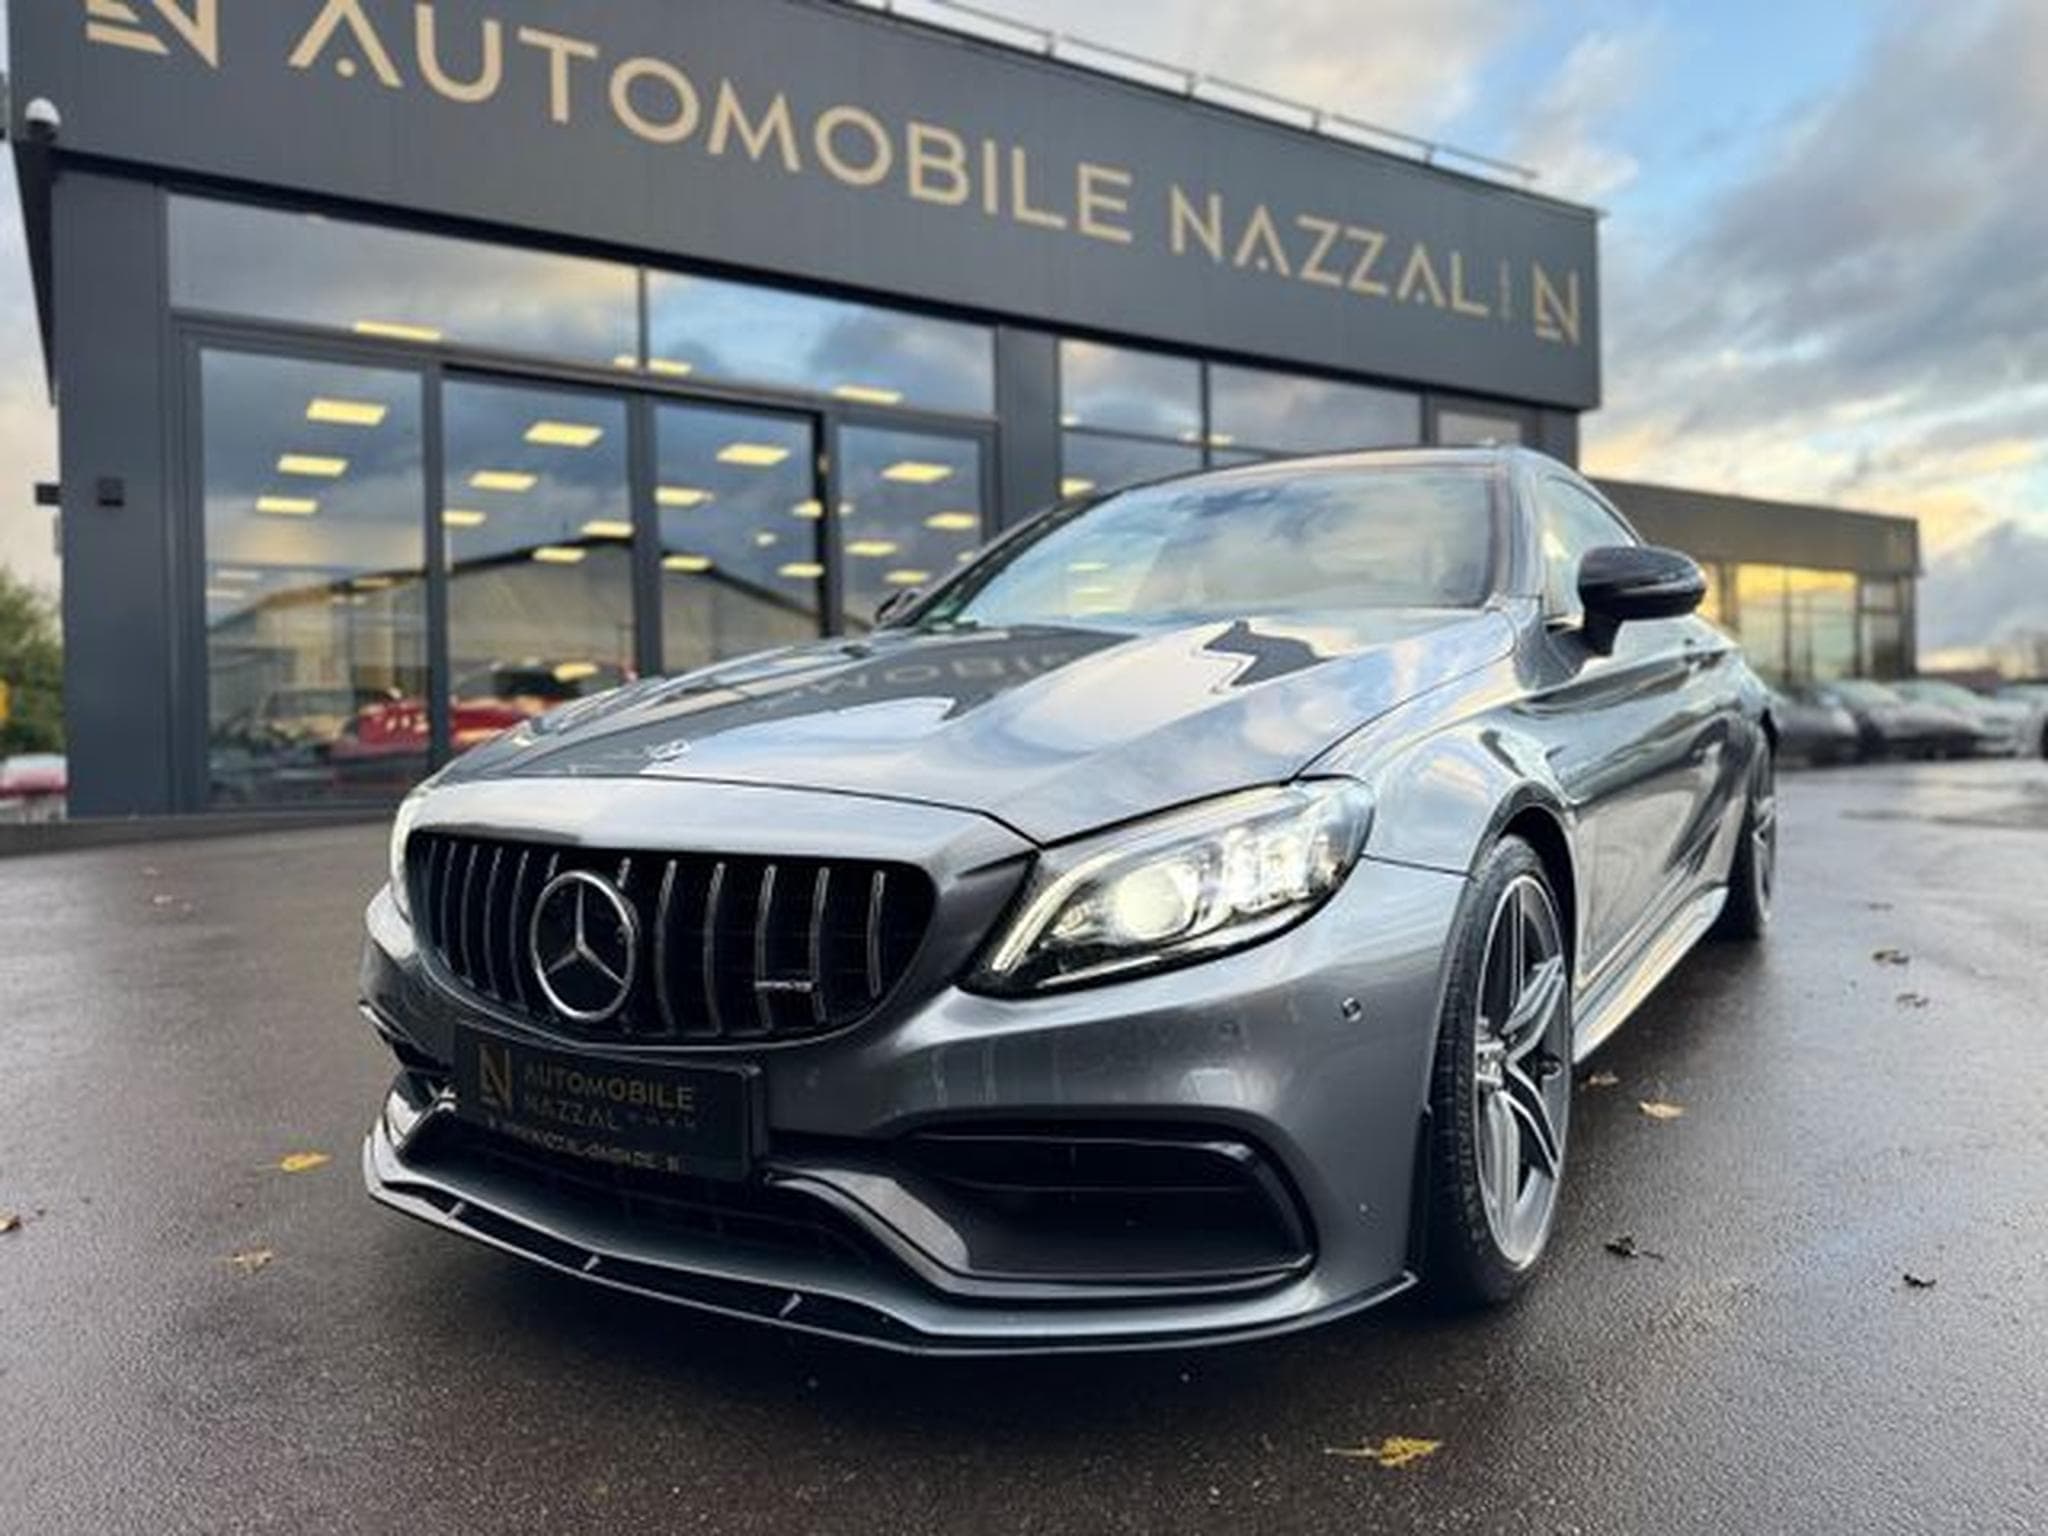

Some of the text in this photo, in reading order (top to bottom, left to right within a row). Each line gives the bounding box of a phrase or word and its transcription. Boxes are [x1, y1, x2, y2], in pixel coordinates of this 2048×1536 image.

[288, 0, 1132, 244] AUTOMOBILE
[1170, 184, 1488, 319] NAZZAL
[523, 1060, 695, 1111] AUTOMOBILE
